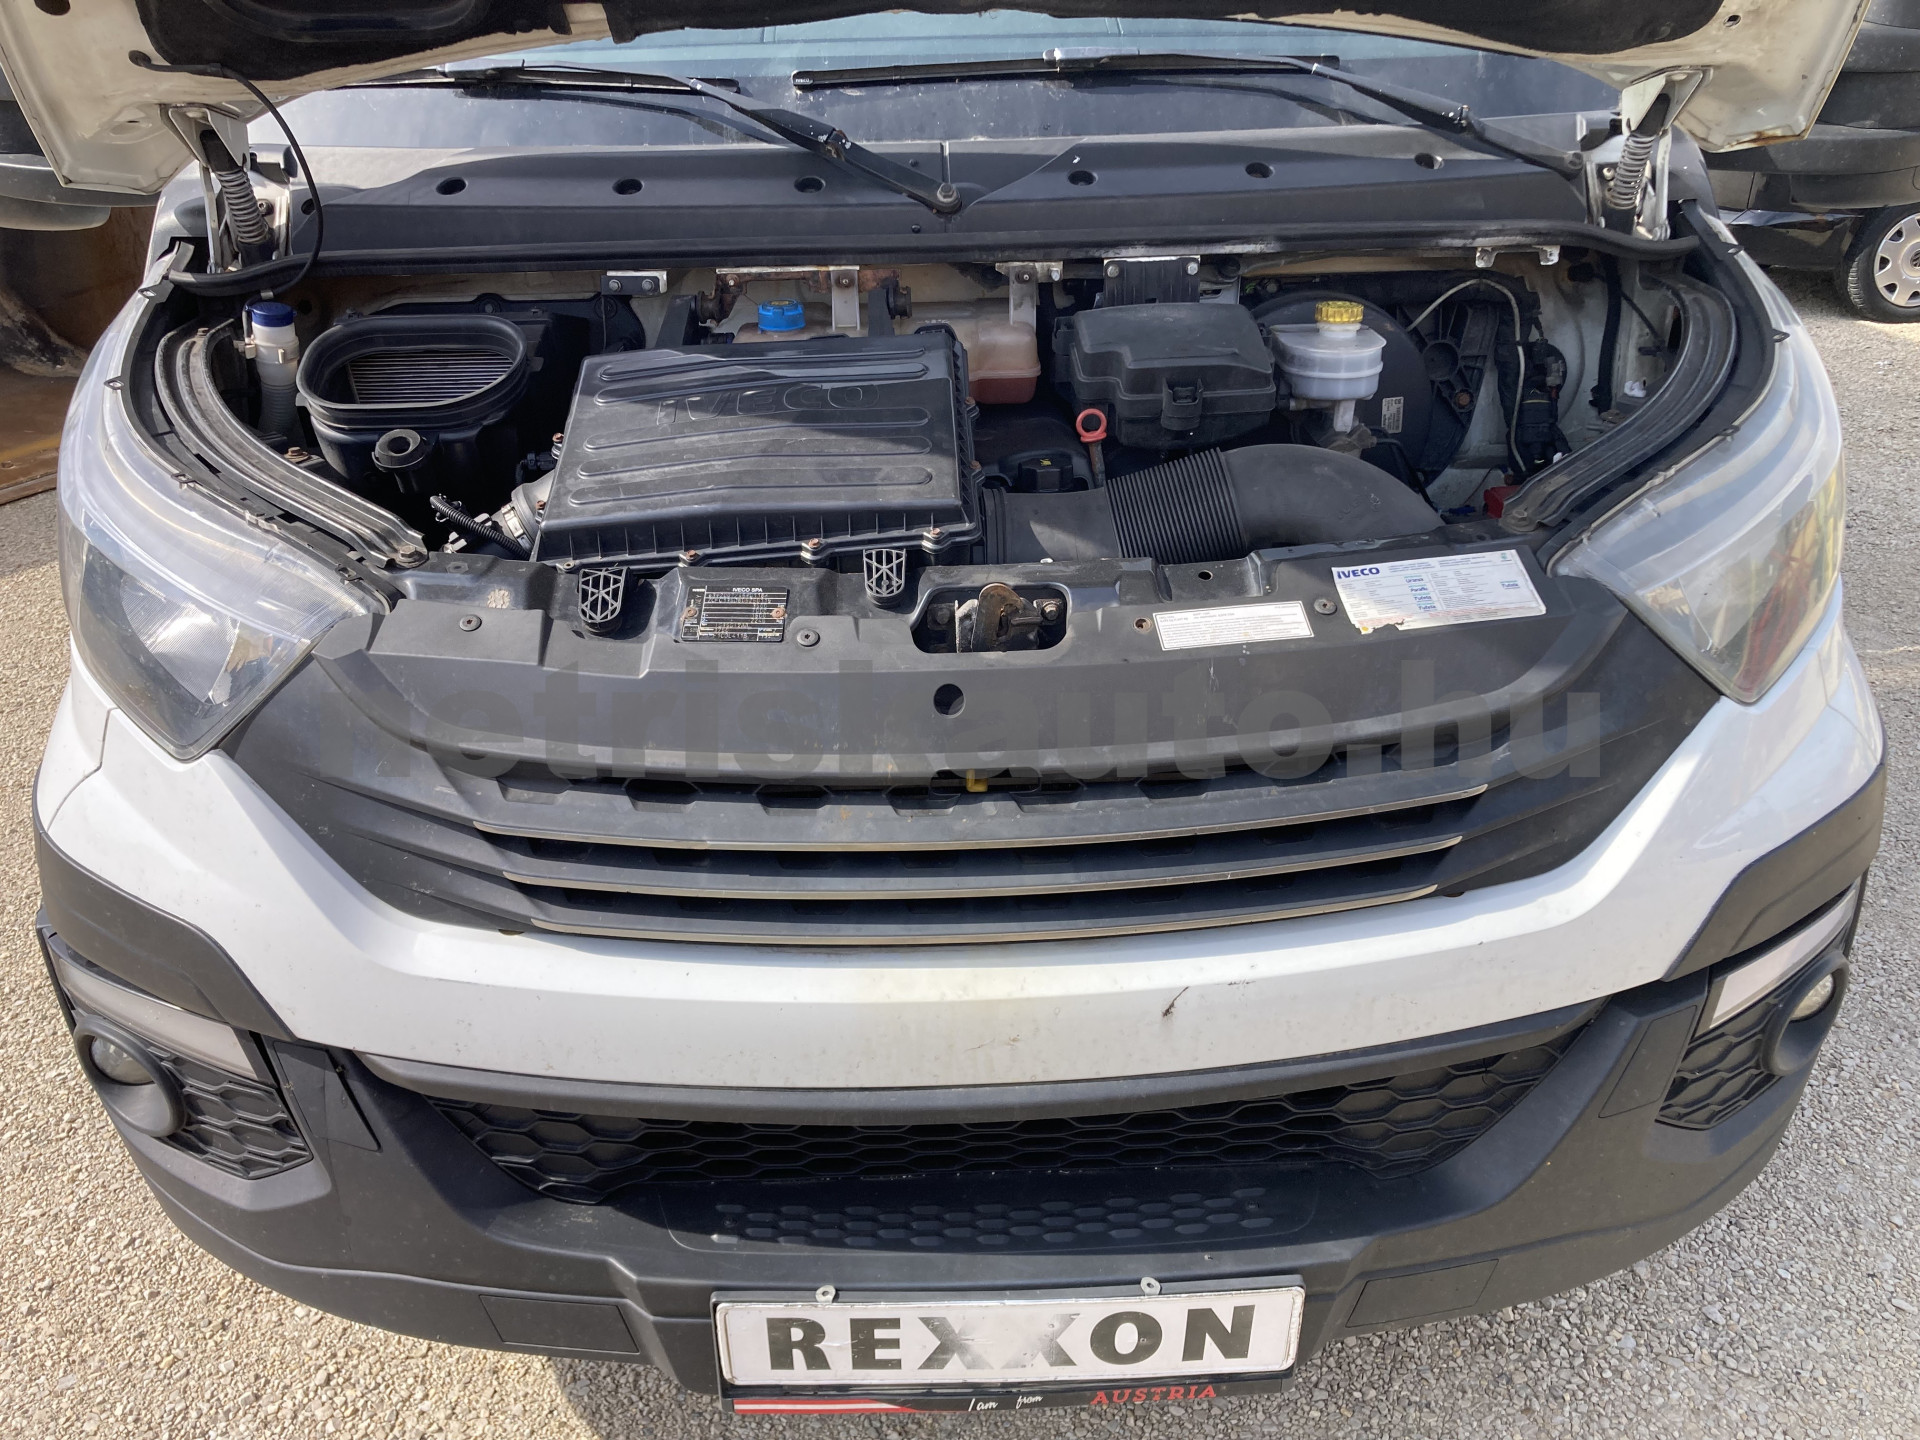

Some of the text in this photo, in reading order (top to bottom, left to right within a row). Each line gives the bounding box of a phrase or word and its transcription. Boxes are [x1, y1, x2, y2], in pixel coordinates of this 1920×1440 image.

[656, 384, 880, 426] IVECO
[1337, 567, 1380, 579] IVECO
[765, 1304, 1256, 1371] REXXON
[968, 1384, 1217, 1411] I am from AUSTRIA
